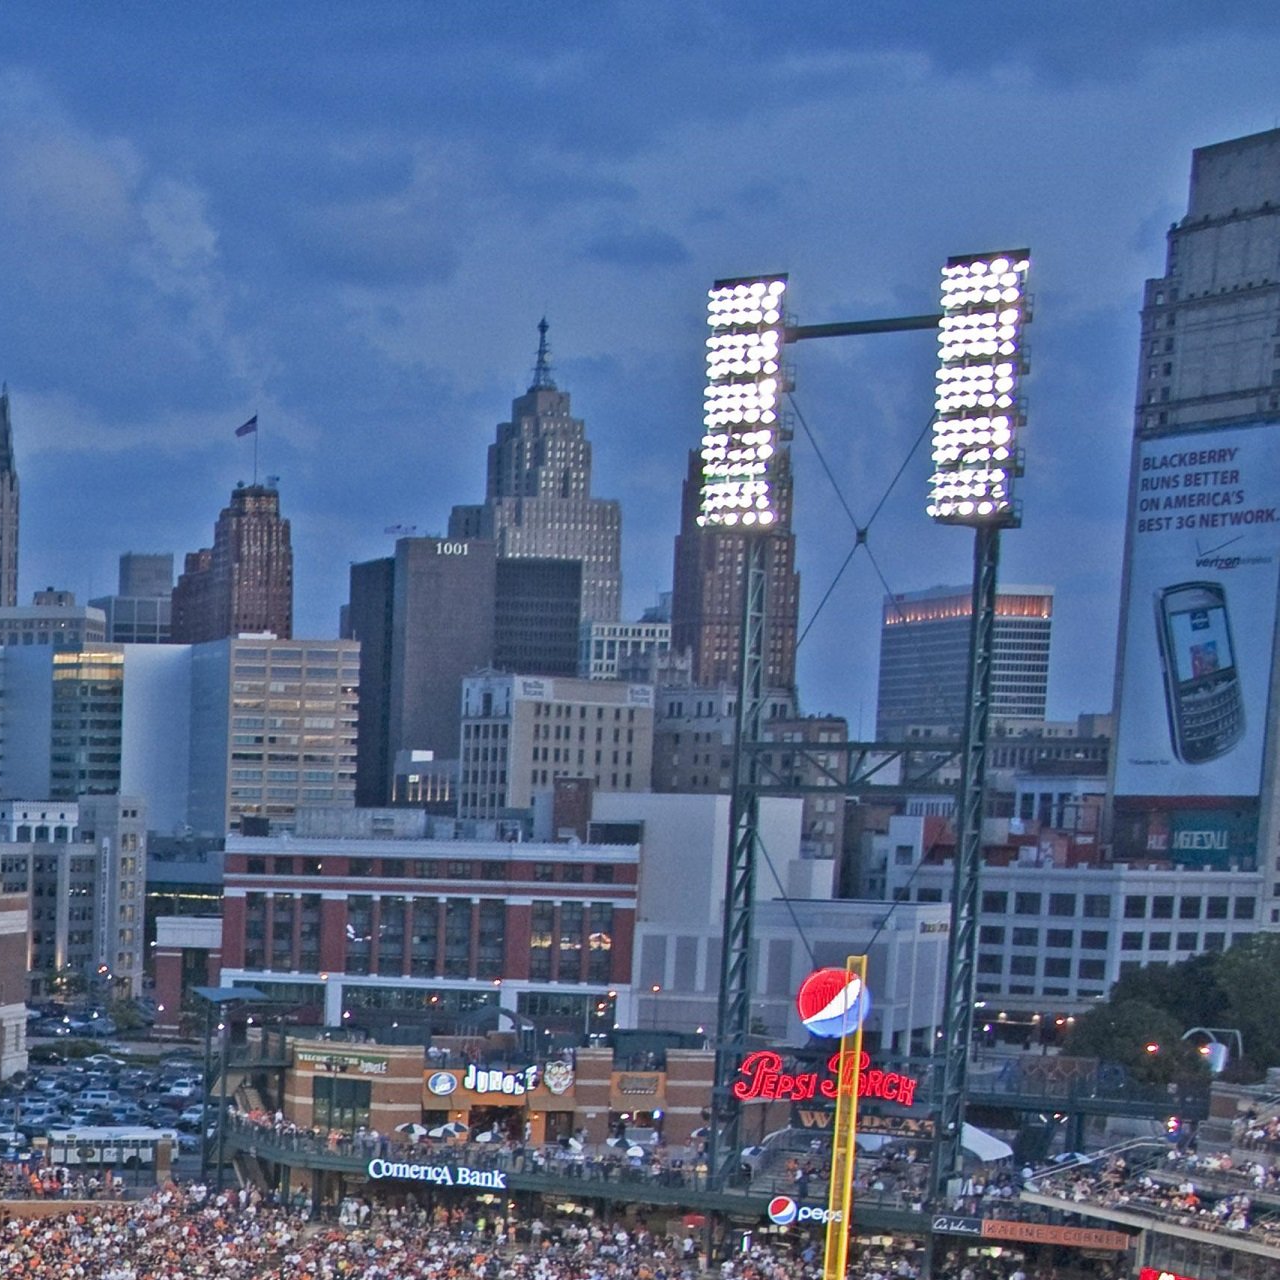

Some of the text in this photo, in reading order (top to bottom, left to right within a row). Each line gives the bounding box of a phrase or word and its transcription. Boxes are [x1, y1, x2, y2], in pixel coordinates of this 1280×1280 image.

[1142, 447, 1238, 471] BLACKBERRY
[1141, 470, 1239, 491] RUNS BETTER
[1140, 490, 1244, 512] ON AMERICA'S
[1137, 517, 1172, 533] BEST
[1176, 514, 1196, 530] 3G
[436, 542, 469, 556] 1001
[734, 1051, 918, 1106] PEPSI PORCH
[456, 1166, 507, 1190] Bank
